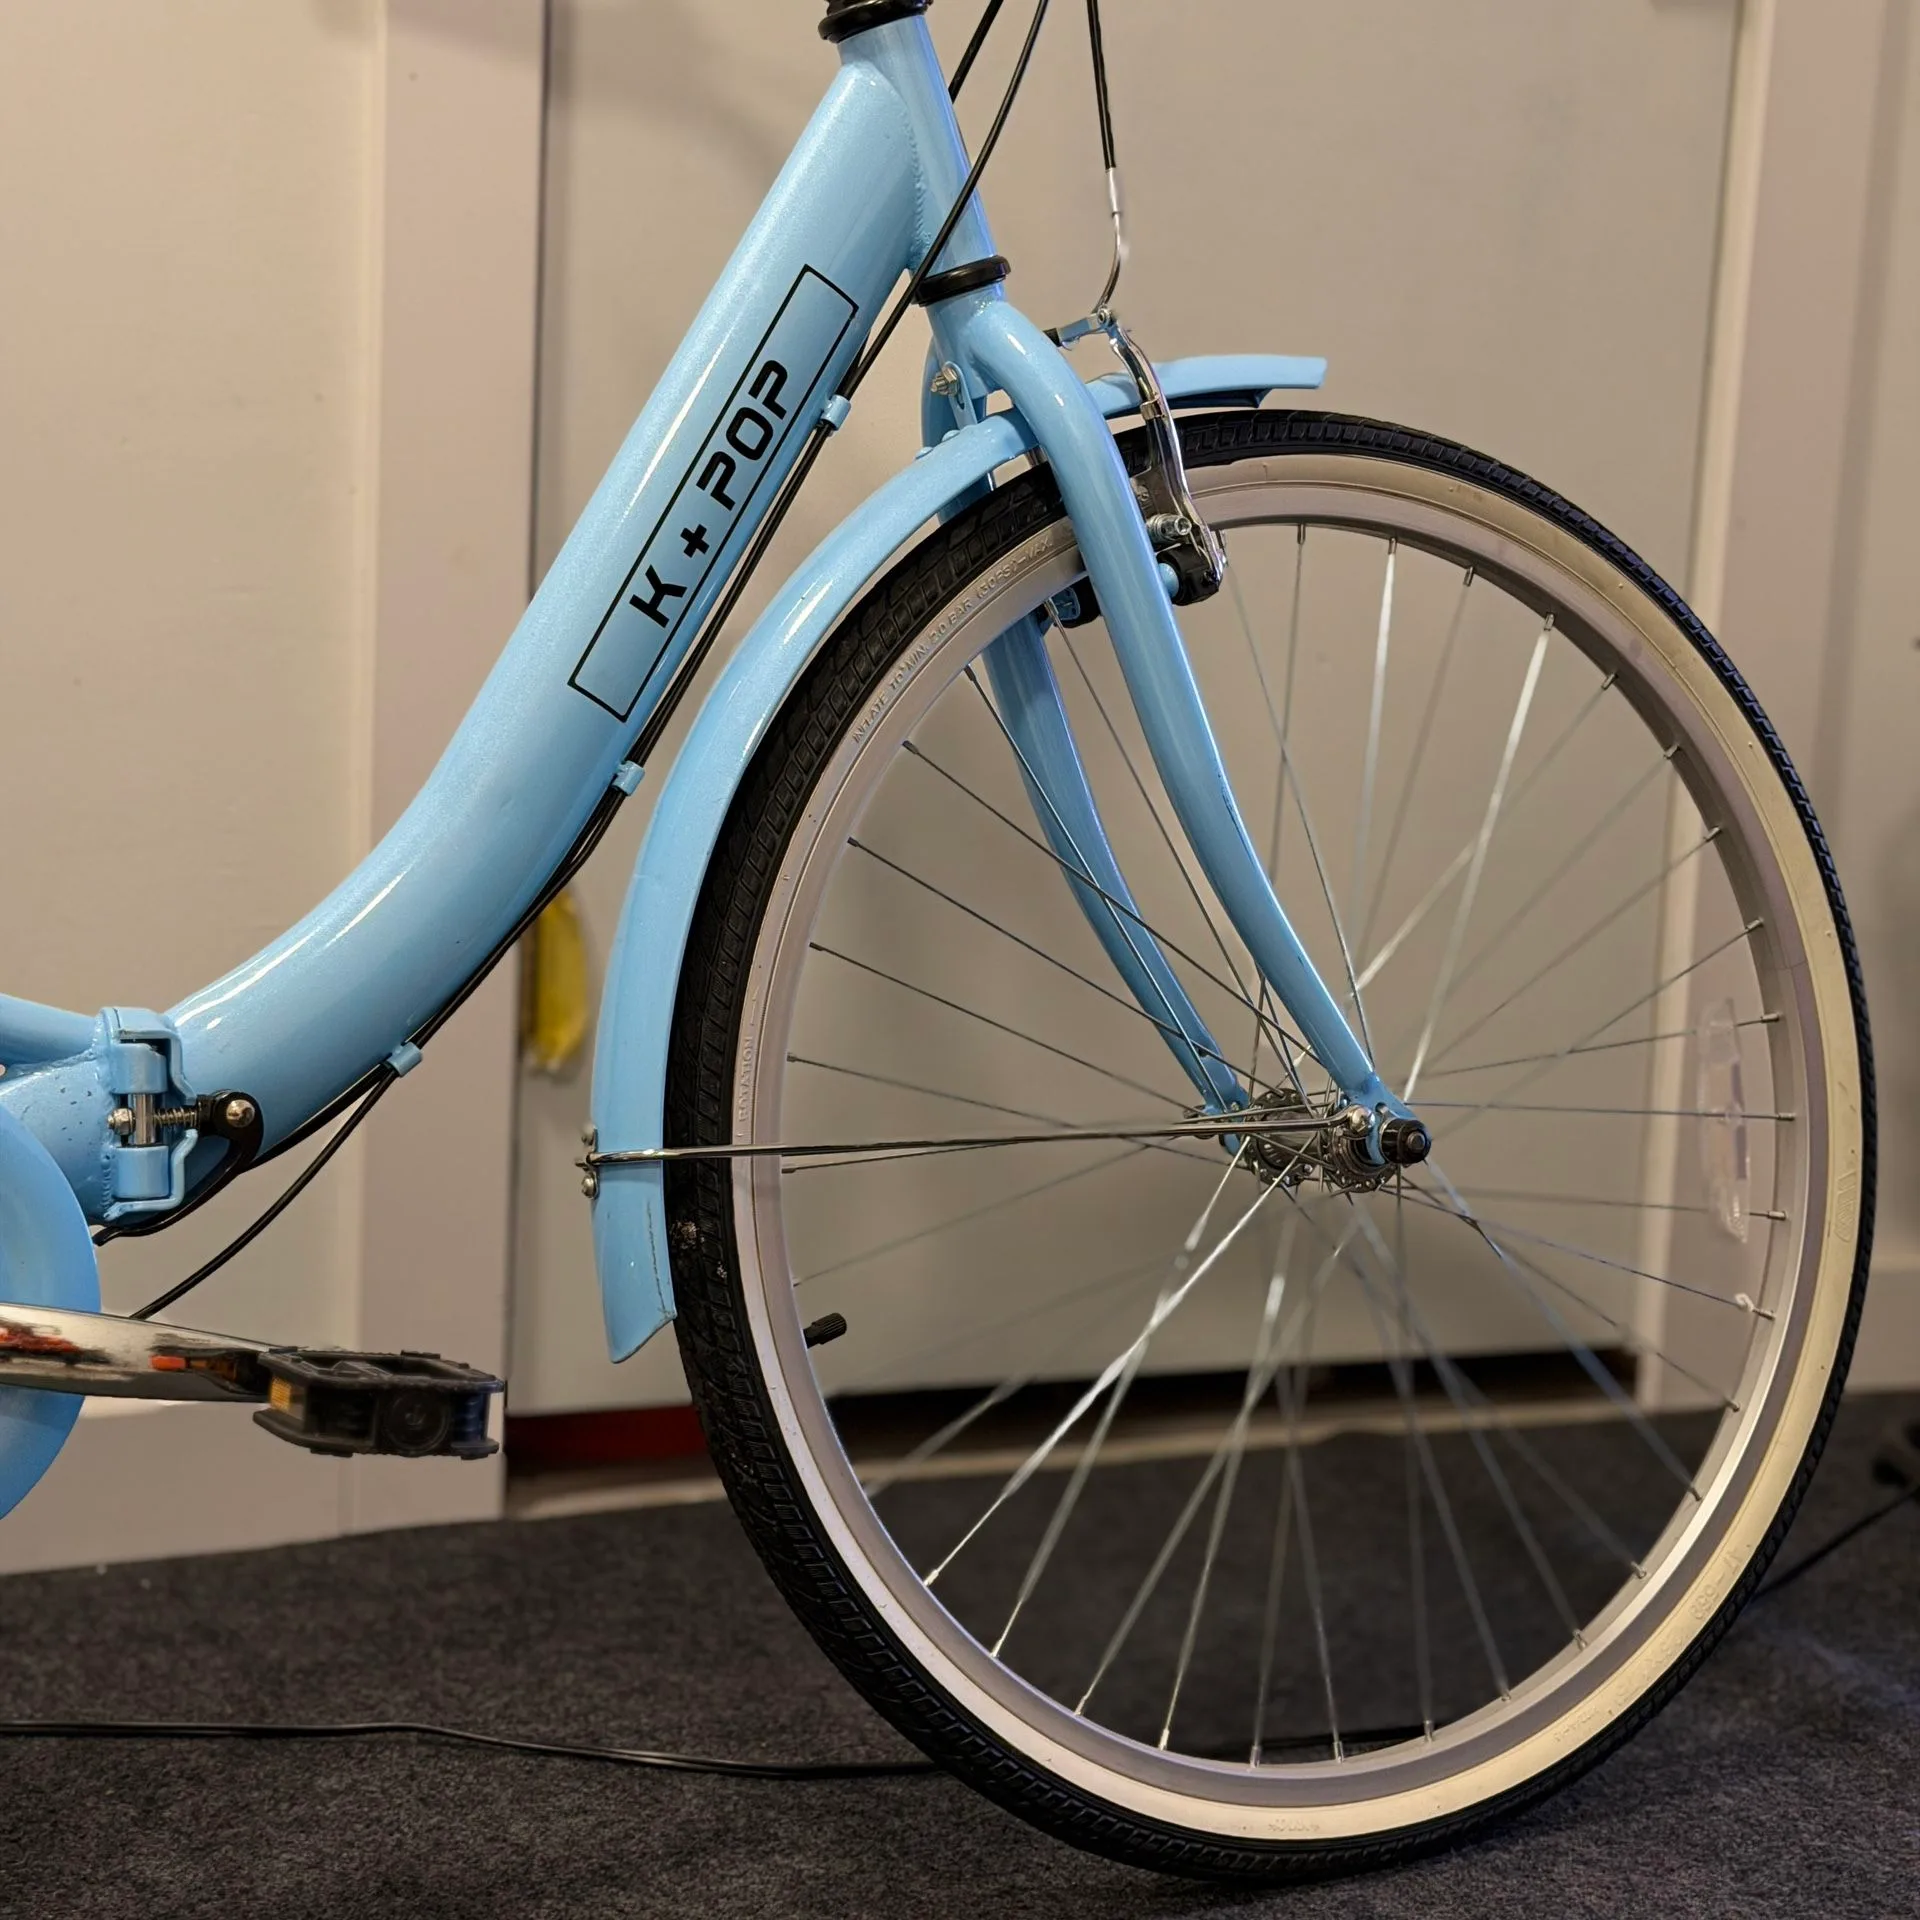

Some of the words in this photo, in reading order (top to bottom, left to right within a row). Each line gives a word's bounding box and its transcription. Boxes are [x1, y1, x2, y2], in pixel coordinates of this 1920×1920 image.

[629, 565, 687, 628] K
[696, 360, 788, 511] POP
[851, 691, 888, 743] INFLATE
